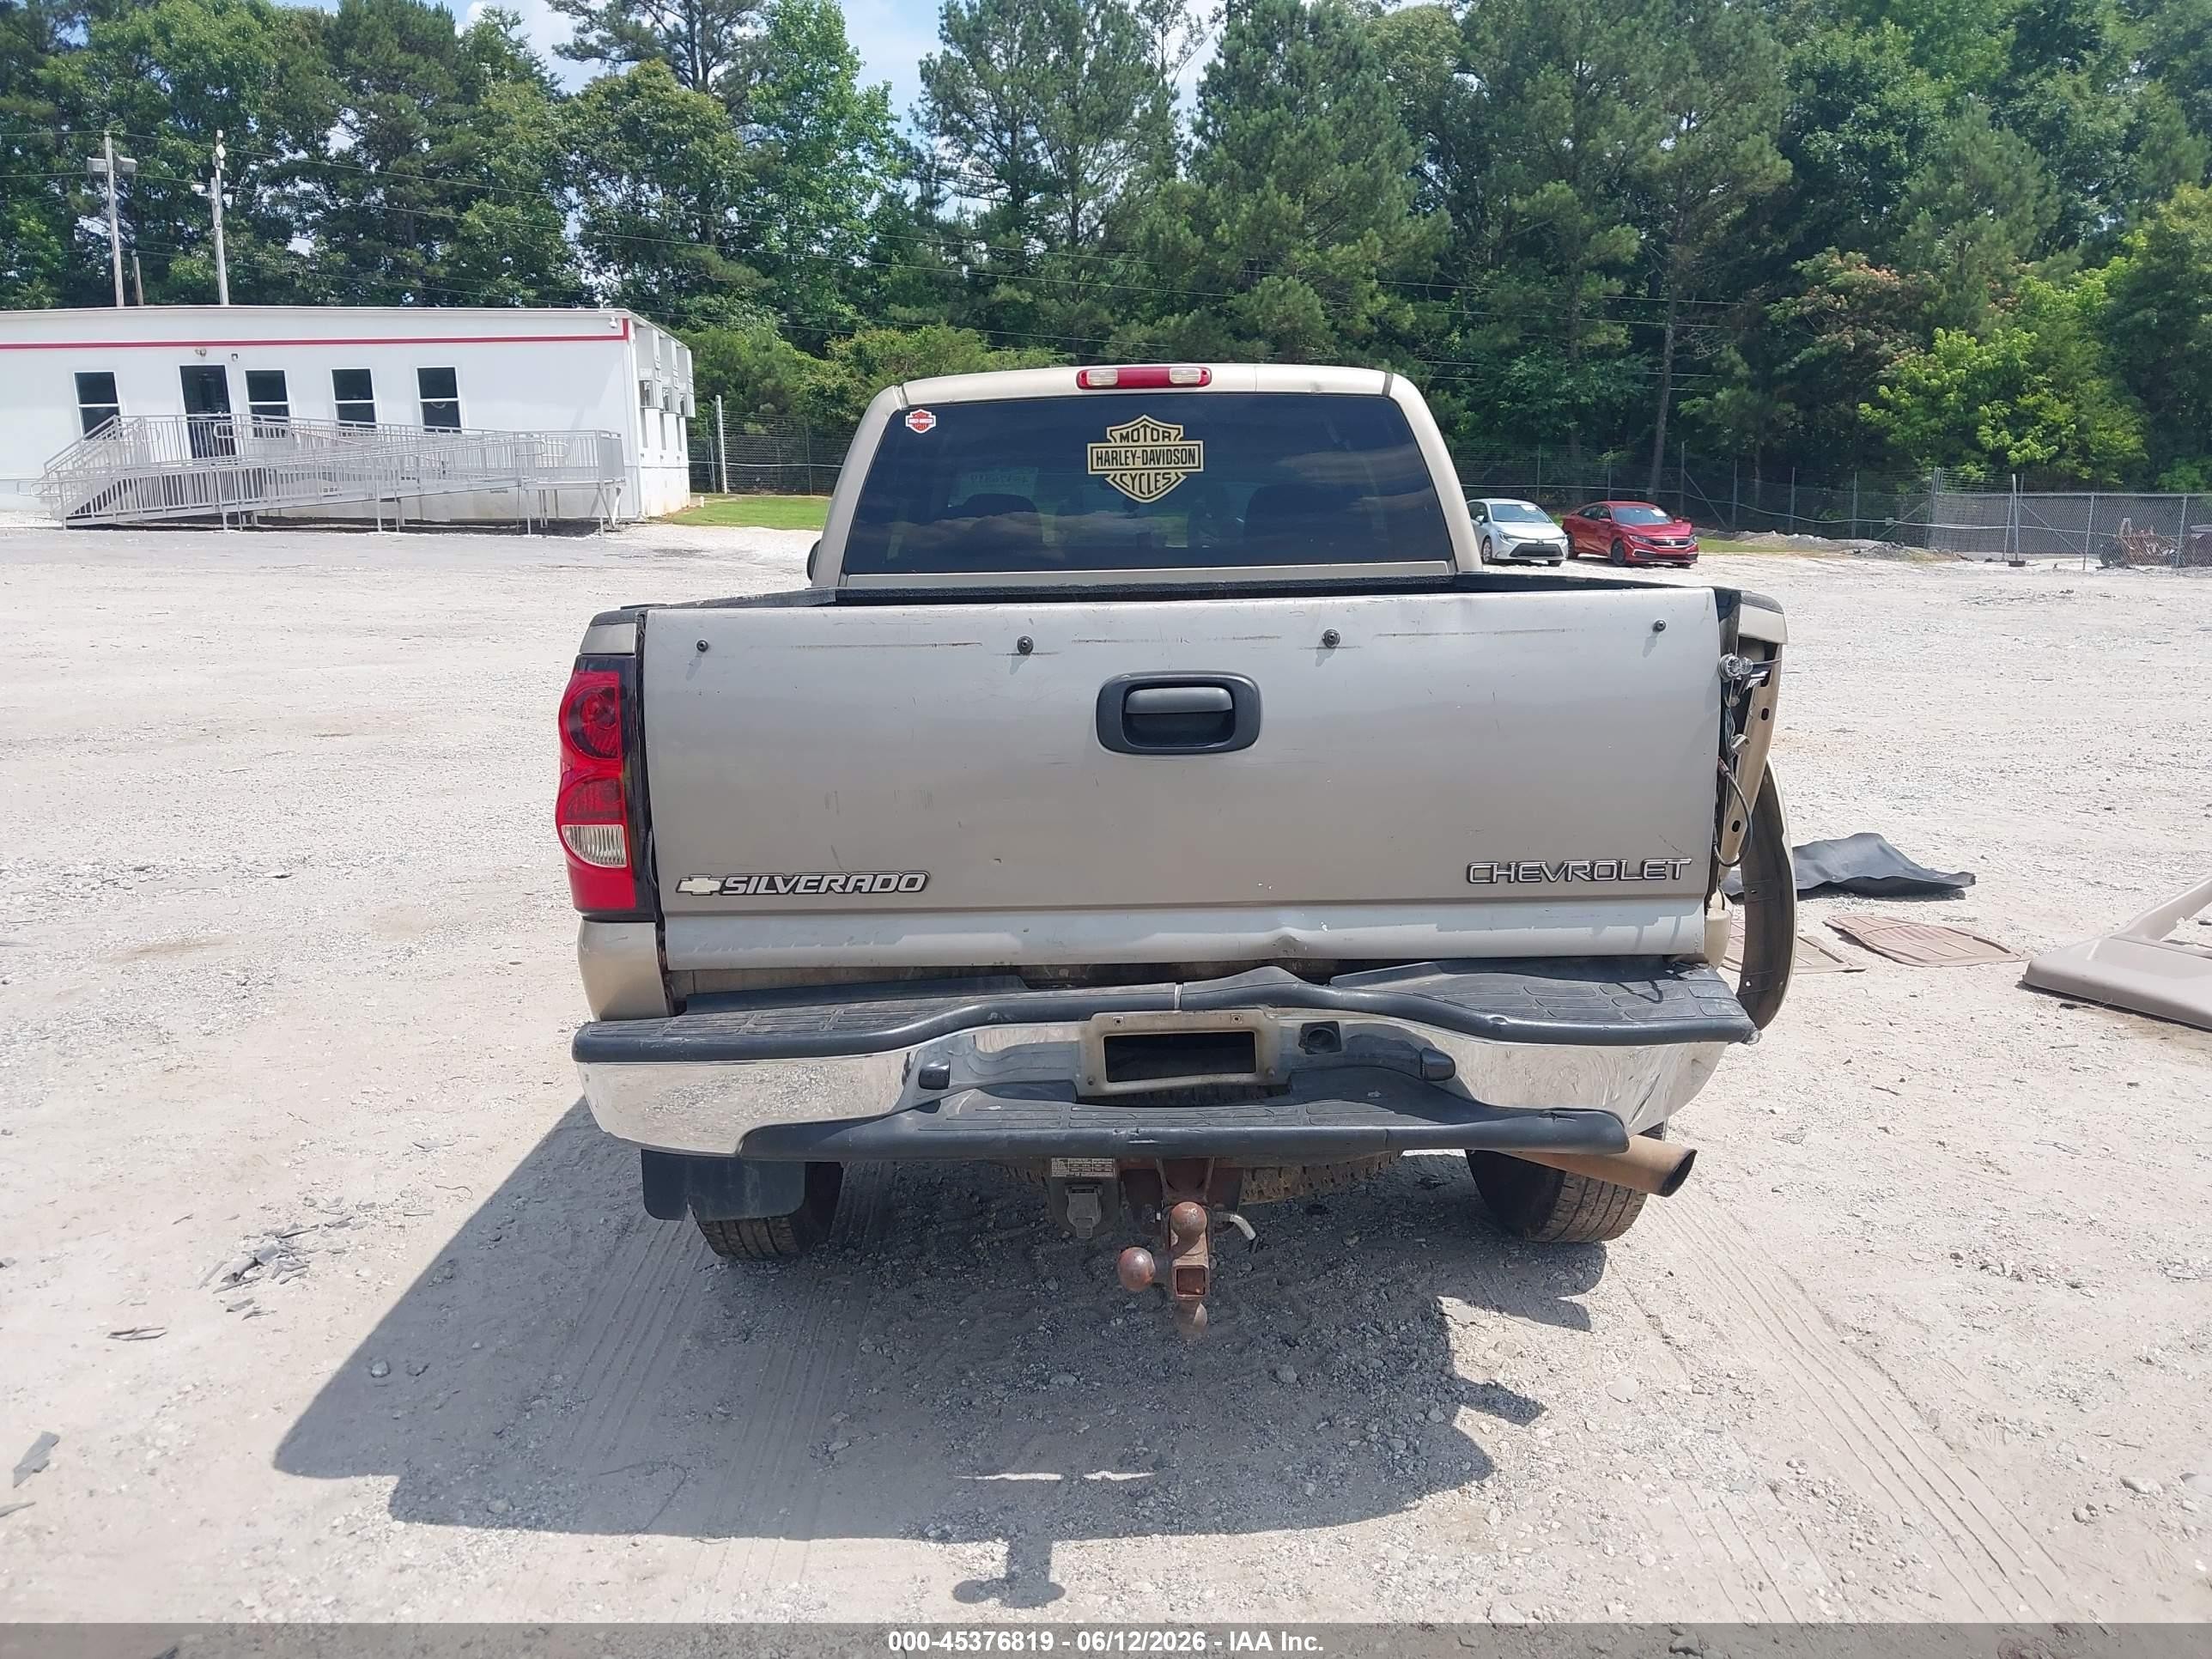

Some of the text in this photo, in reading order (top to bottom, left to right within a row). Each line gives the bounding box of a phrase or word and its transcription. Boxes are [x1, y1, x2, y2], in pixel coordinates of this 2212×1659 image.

[1119, 423, 1172, 443] MOTOR
[1096, 447, 1196, 467] HARLEY-DAVIDSON
[1119, 472, 1173, 495] CYCLES
[1467, 858, 1692, 884] CHEVROLET
[721, 873, 929, 895] SILVERADO
